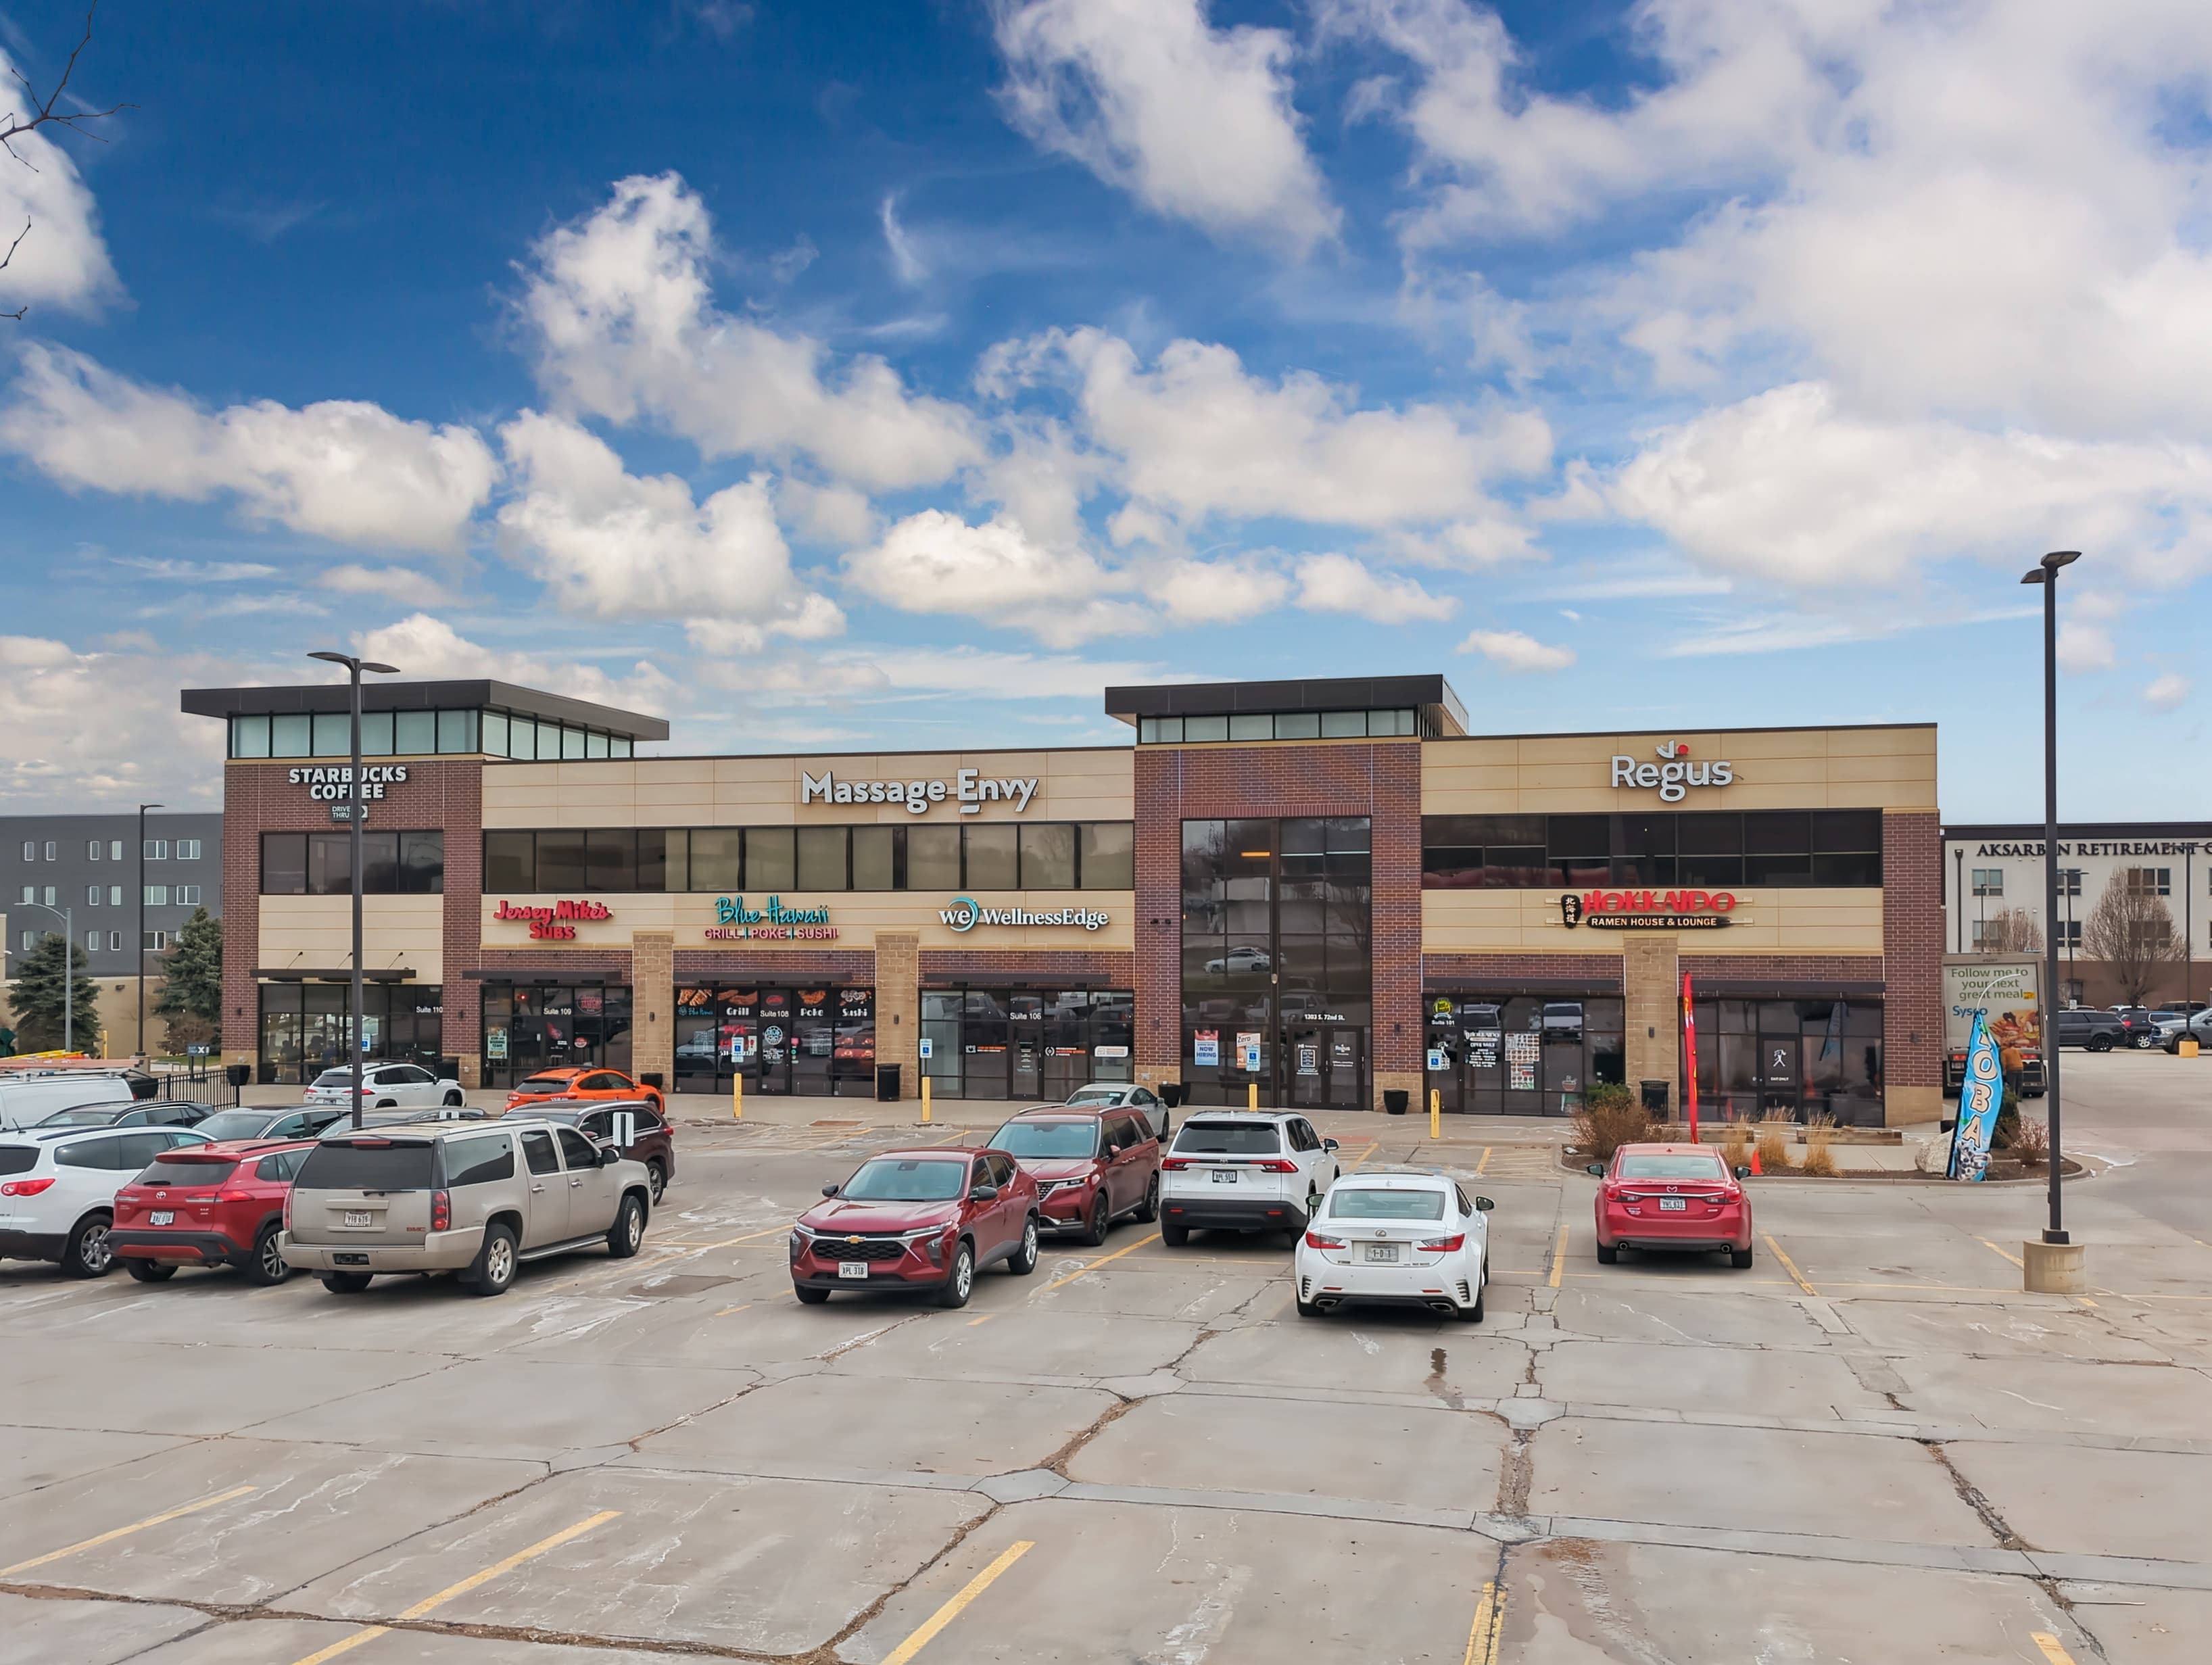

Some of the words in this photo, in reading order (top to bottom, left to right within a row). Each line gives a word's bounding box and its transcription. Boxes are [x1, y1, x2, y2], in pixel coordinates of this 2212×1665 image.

[1612, 755, 1733, 802] Regus
[802, 771, 946, 814] Massage
[957, 768, 1038, 813] Envy
[1977, 843, 2070, 856] AKSARBN
[2077, 842, 2198, 856] RETIREMENT
[1583, 890, 1736, 915] HOKKAIDO
[494, 900, 554, 925] Jersey
[554, 900, 610, 920] Mike's
[715, 895, 761, 925] Blue
[767, 894, 830, 925] Hawaii
[1565, 896, 1577, 924] 北海道
[938, 909, 971, 925] we
[982, 908, 1110, 930] WellnessEdge
[1591, 918, 1627, 926] RAMEN
[1631, 918, 1664, 926] HOUSE
[1667, 917, 1675, 926] &
[1677, 918, 1717, 926] LOUNGE
[704, 928, 741, 939] GRILL
[751, 928, 788, 939] POKE
[796, 927, 838, 939] SUSHI
[1951, 968, 1990, 978] Follow
[2015, 968, 2028, 976] to
[1962, 980, 1990, 990] your
[1991, 978, 2019, 988] next
[1959, 990, 1990, 1001] great
[1994, 989, 2023, 999] meal
[726, 1007, 750, 1016] Grill
[760, 1009, 776, 1017] Suite
[800, 1008, 824, 1017] Poke
[842, 1008, 868, 1017] Sushi
